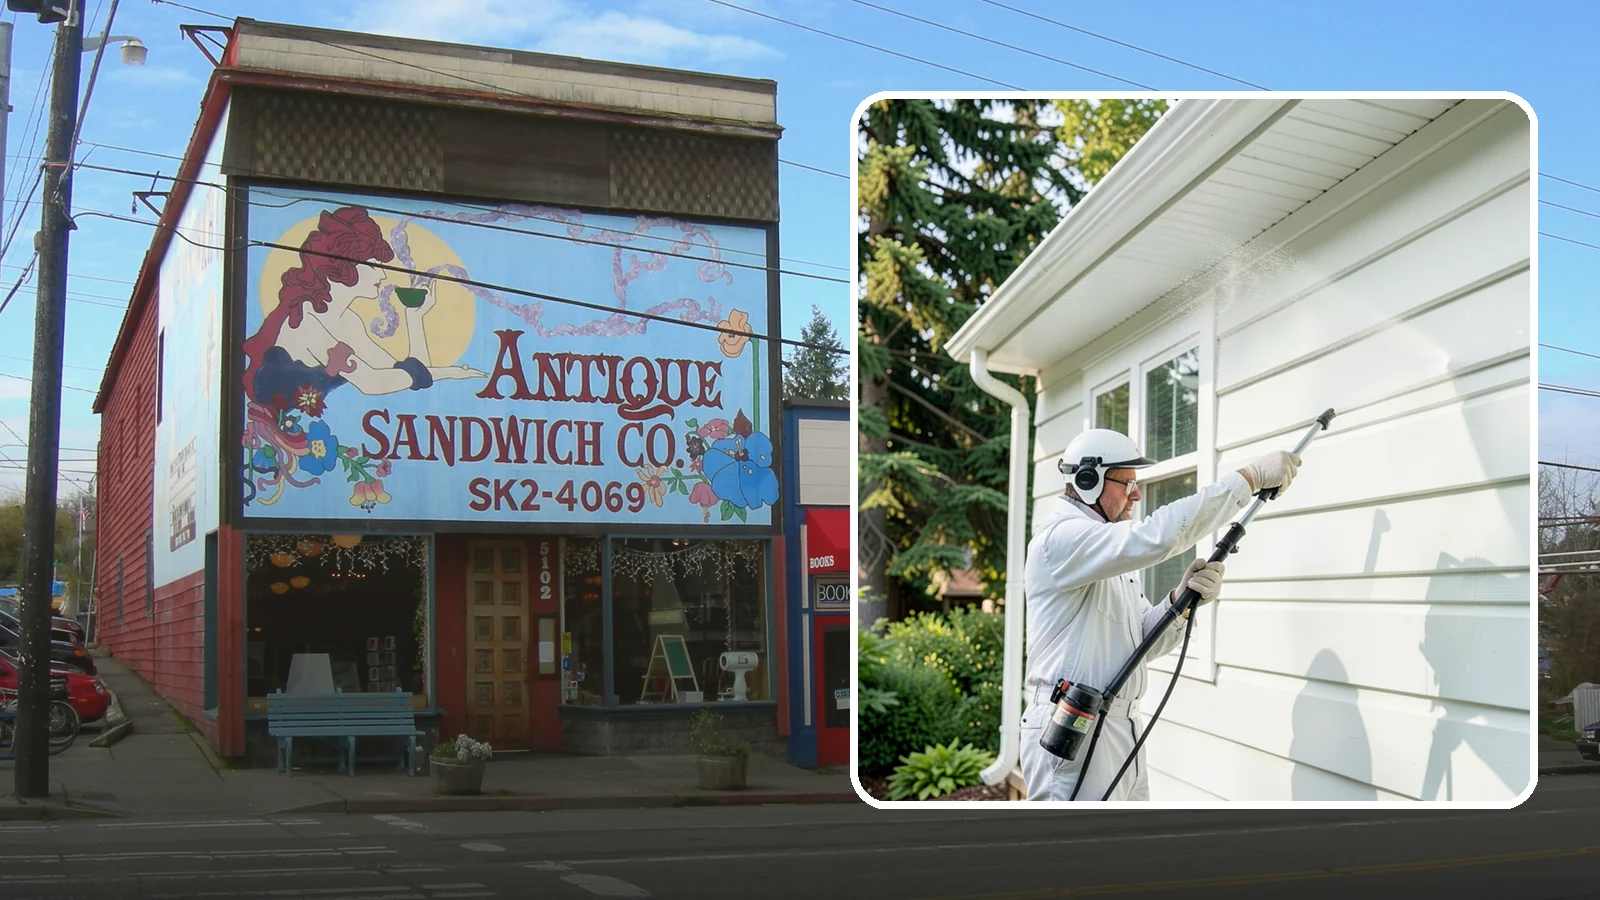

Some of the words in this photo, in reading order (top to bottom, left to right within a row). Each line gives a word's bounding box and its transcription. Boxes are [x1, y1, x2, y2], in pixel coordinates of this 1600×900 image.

[361, 408, 605, 468] SANDWICH
[617, 421, 685, 468] CO.
[469, 477, 646, 514] SK2-4069
[539, 541, 551, 600] 5102
[809, 554, 835, 569] BOOKS
